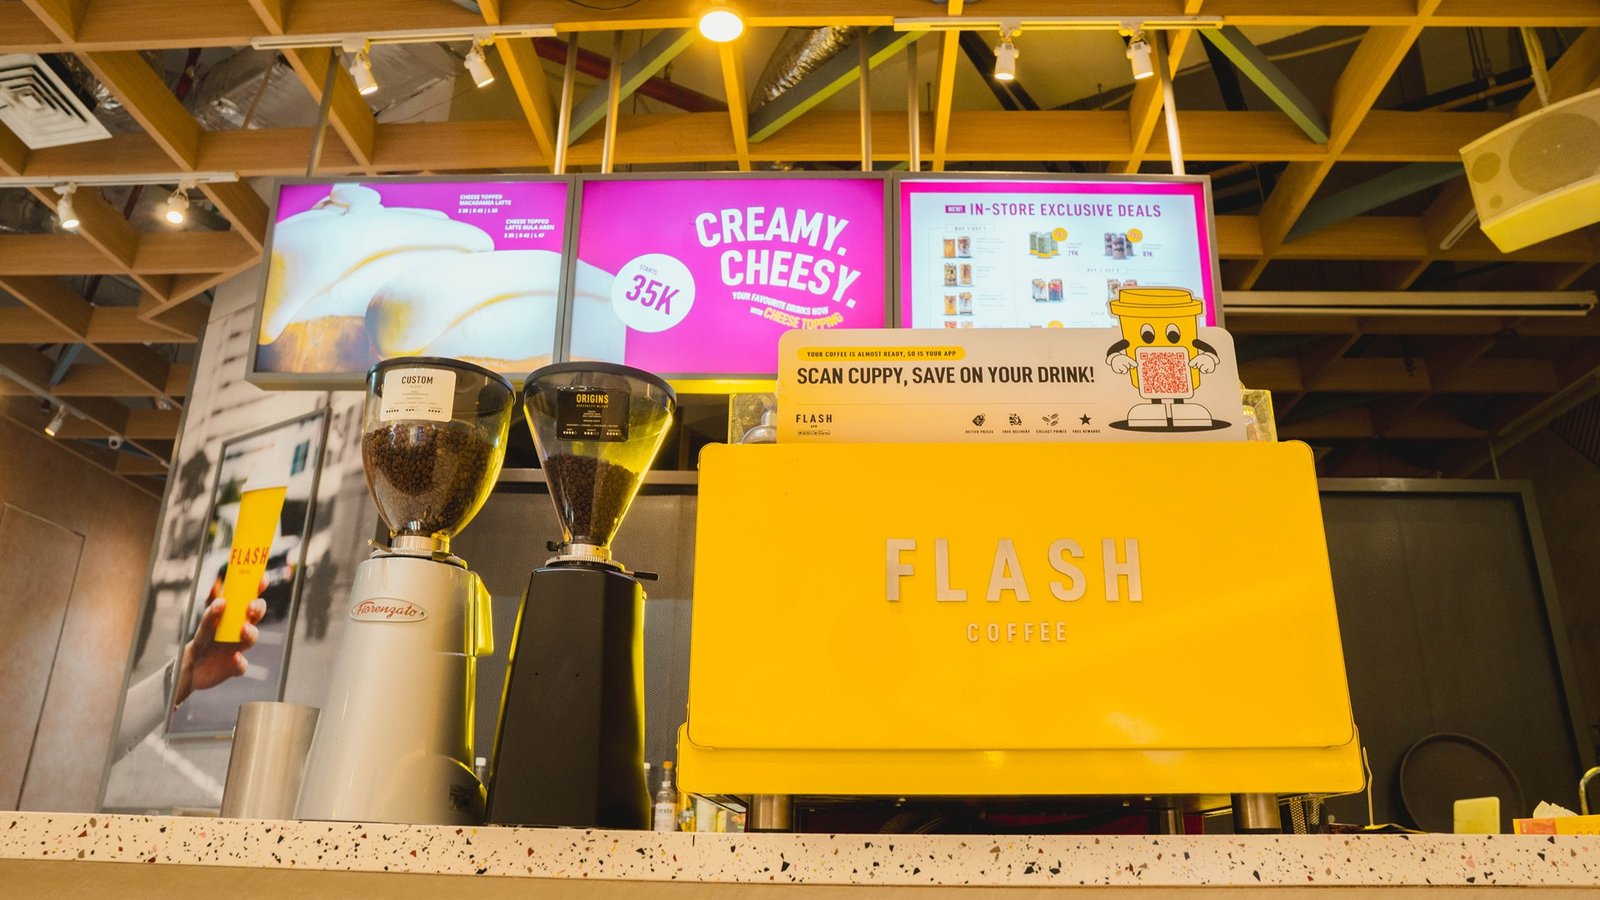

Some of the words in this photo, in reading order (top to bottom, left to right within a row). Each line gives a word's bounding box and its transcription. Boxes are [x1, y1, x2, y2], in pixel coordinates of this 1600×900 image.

[970, 203, 1036, 216] IN-STORE
[1039, 204, 1114, 217] EXCLUSIVE
[1118, 205, 1162, 218] DEALS
[695, 206, 849, 257] CREAMY.
[720, 250, 861, 309] CHEESY.
[626, 275, 680, 316] 35K
[732, 291, 752, 300] YOUR
[752, 292, 787, 310] FAVOURITE
[786, 303, 812, 316] DRINKS
[812, 306, 829, 316] NOW
[763, 307, 800, 328] CHEESE
[800, 312, 846, 330] TOPPING
[401, 376, 434, 384] CUSTOM
[796, 367, 844, 384] SCAN
[848, 367, 908, 387] CUPPY,
[912, 366, 956, 384] SAVE
[960, 366, 984, 384] ON
[988, 366, 1034, 383] YOUR
[1038, 366, 1096, 383] DRINK!
[576, 394, 609, 404] ORIGINS
[796, 414, 832, 423] FLASH
[230, 546, 270, 566] FLASH
[886, 537, 1144, 603] FLASH
[356, 600, 418, 619] Fiorenzato
[966, 622, 1067, 644] COFFEE
